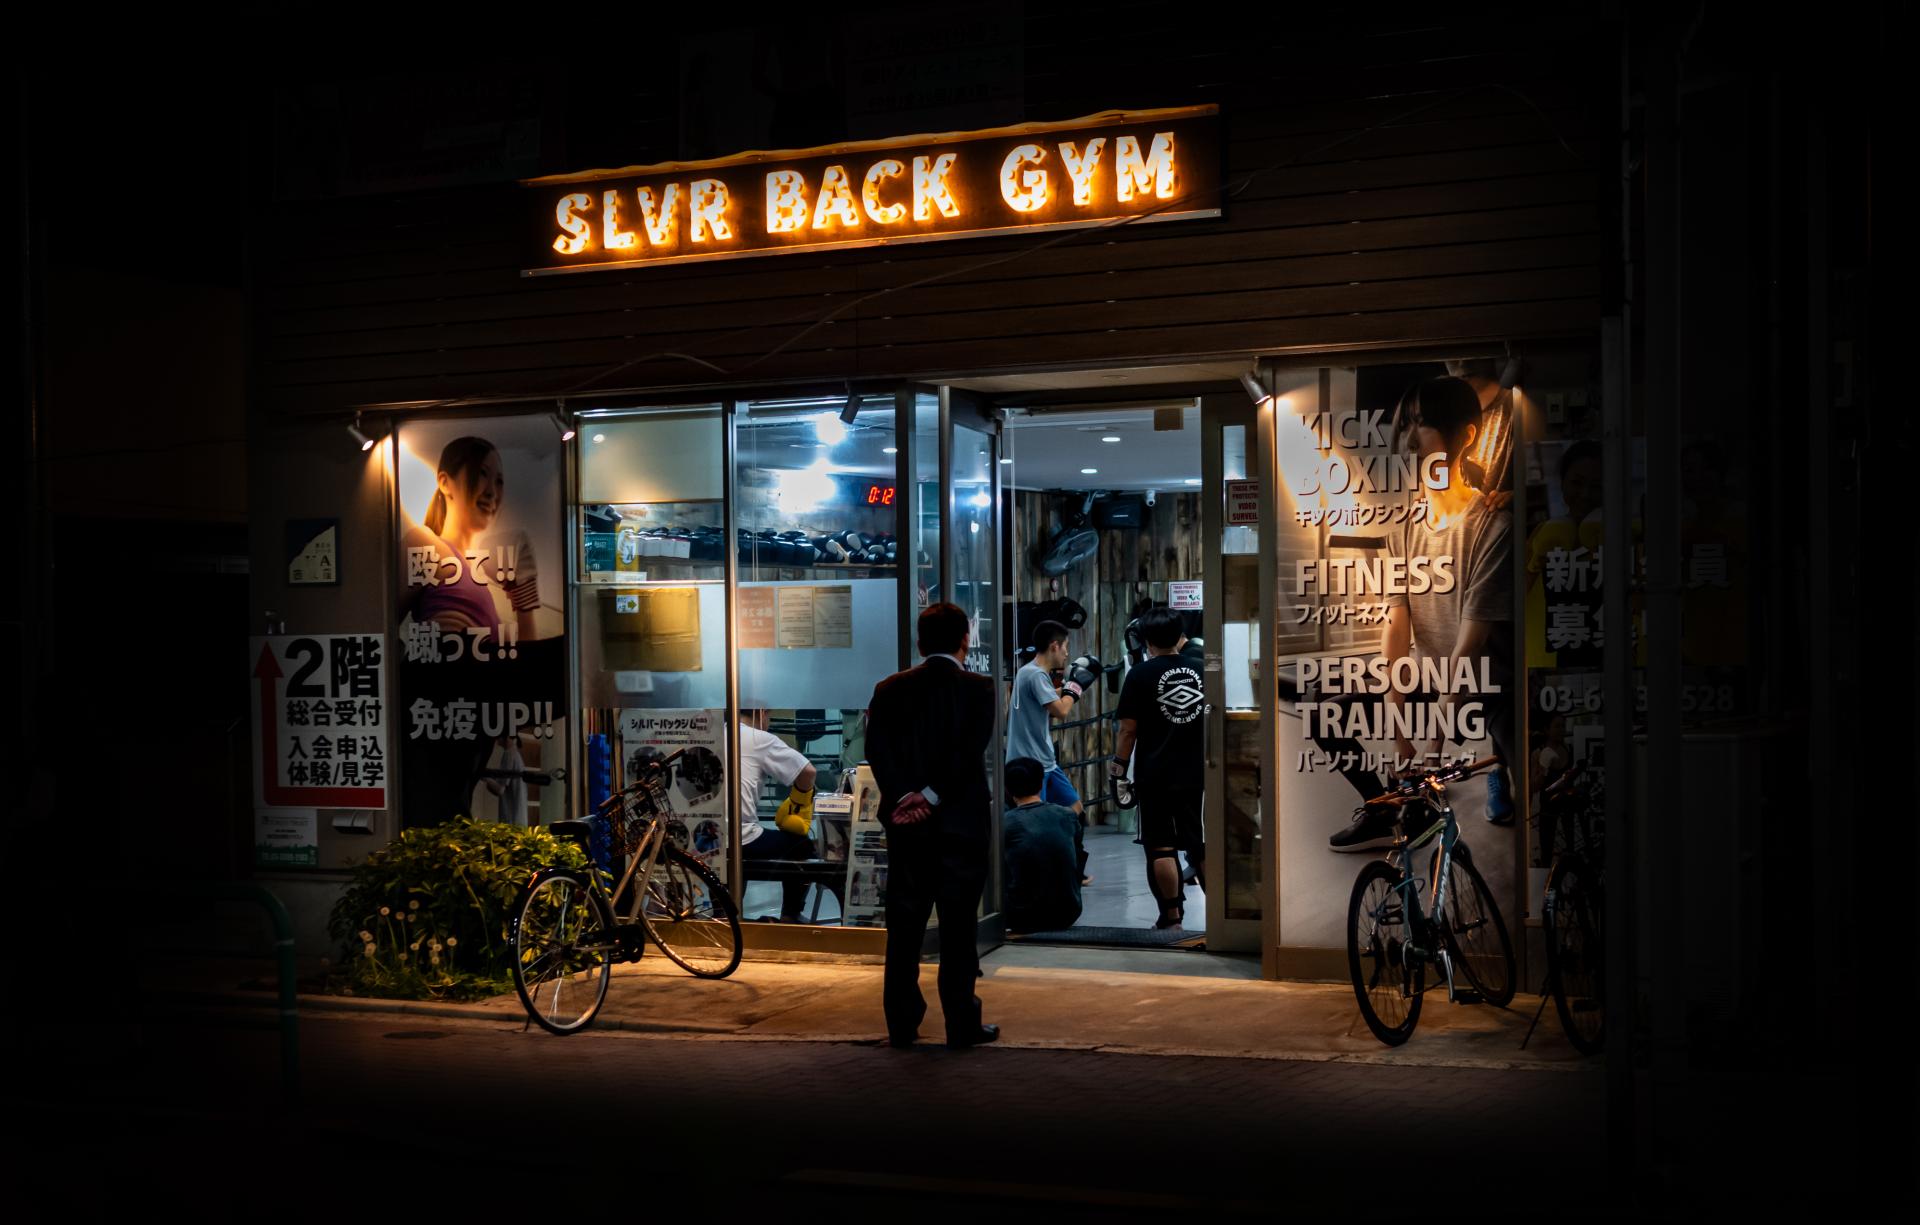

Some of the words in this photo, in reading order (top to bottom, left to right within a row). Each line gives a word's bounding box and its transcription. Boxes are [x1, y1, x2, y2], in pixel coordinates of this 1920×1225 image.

[553, 178, 733, 254] SLVR
[766, 152, 961, 233] BACK
[999, 131, 1176, 212] GYM
[1297, 409, 1387, 450] KICK
[1297, 451, 1449, 496] BOXING
[1296, 499, 1429, 528] キックボクシング
[1295, 555, 1456, 597] FITNESS
[1295, 602, 1393, 625] フィットネス
[285, 637, 381, 698] 2階
[1158, 667, 1204, 694] INTERNATIONAL
[1295, 656, 1502, 698] PERSONAL
[287, 700, 382, 726] 総合受付
[409, 697, 555, 742] 免疫UP!!
[1295, 701, 1488, 740] TRAINING
[288, 735, 384, 760] 入会申込
[287, 762, 384, 787] 体験/見学
